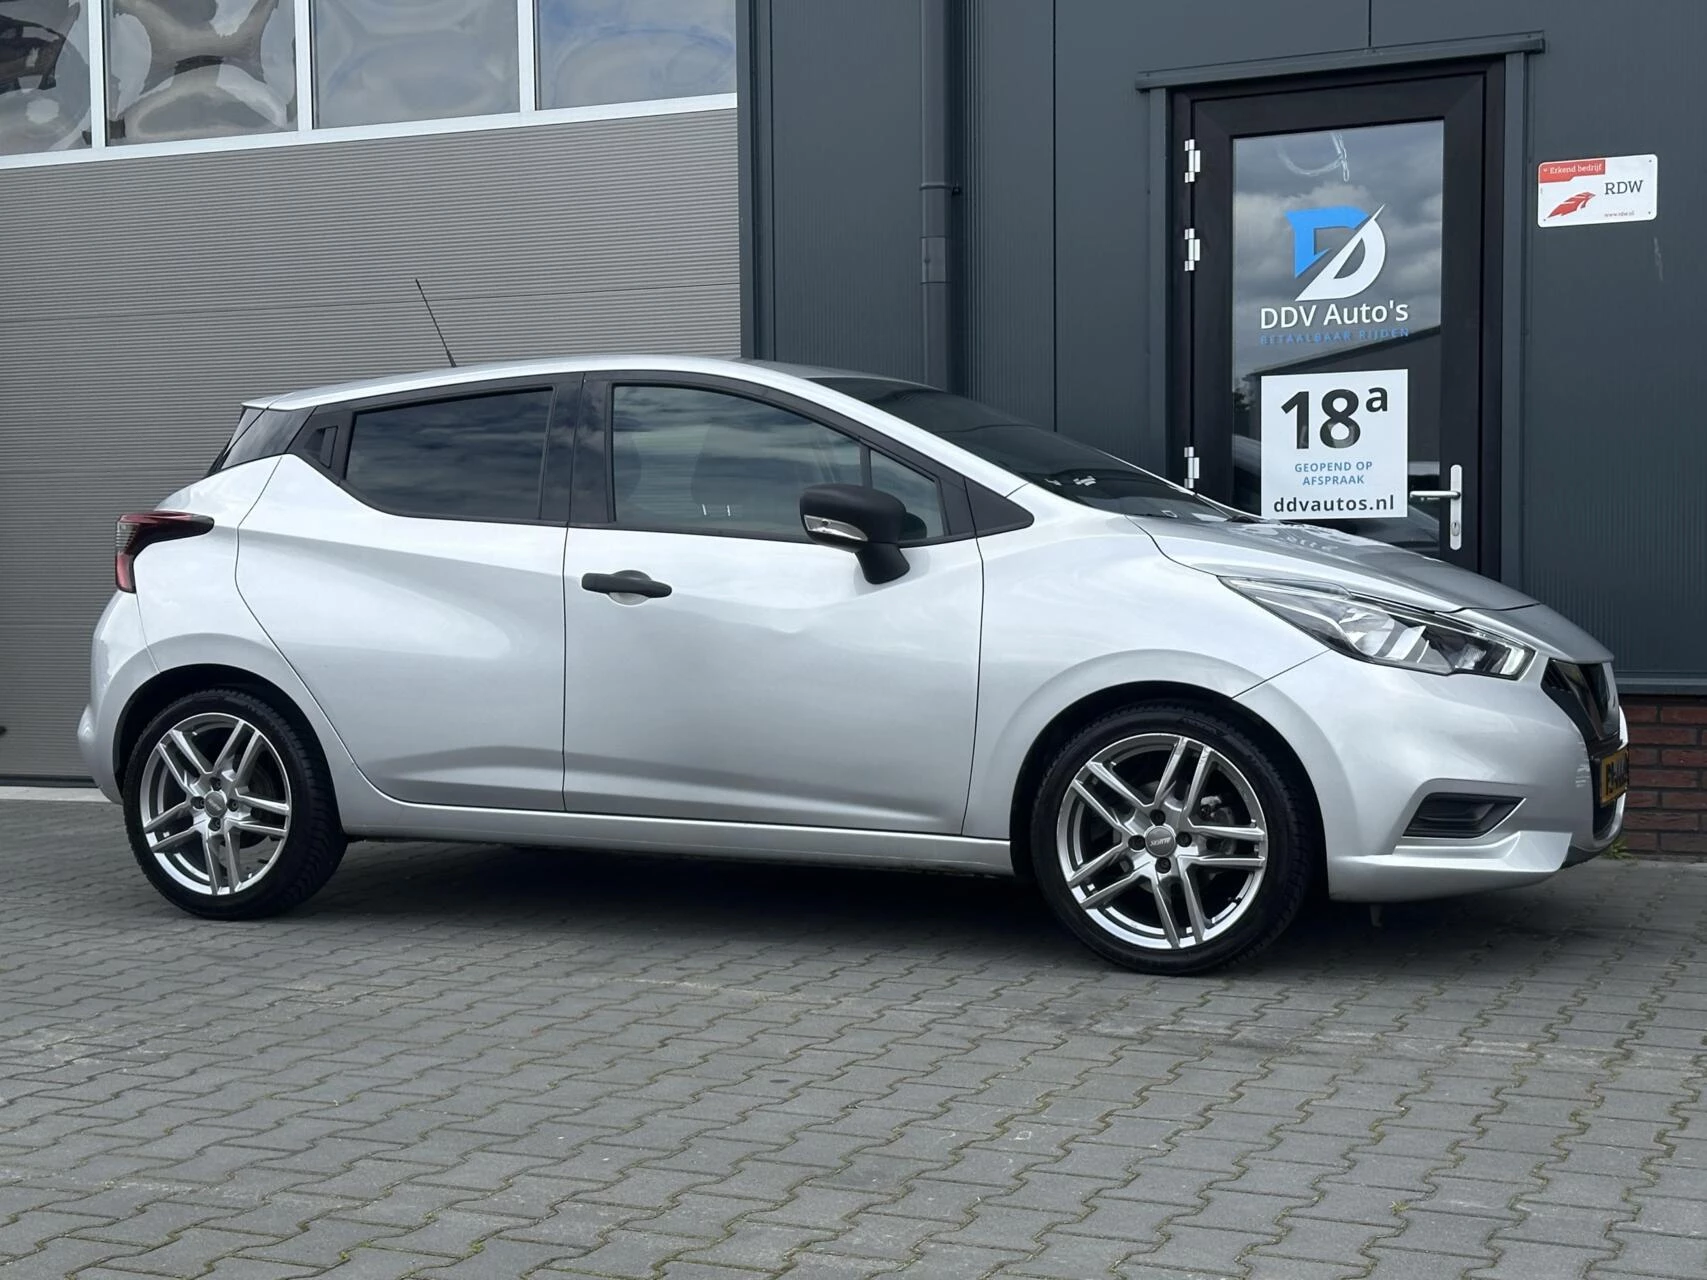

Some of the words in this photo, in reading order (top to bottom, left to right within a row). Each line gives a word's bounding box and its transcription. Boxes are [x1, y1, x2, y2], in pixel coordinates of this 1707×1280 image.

[1550, 166, 1576, 175] Erkend
[1577, 163, 1602, 173] bedrijf
[1604, 180, 1644, 195] RDW
[1260, 305, 1317, 330] DDV
[1323, 300, 1409, 326] Auto's
[1359, 327, 1409, 340] RIJDEN
[1294, 461, 1352, 473] GEOPEND
[1356, 461, 1373, 471] OP
[1302, 475, 1365, 486] AFSPRAAK
[1273, 494, 1395, 512] ddvautos.nl
